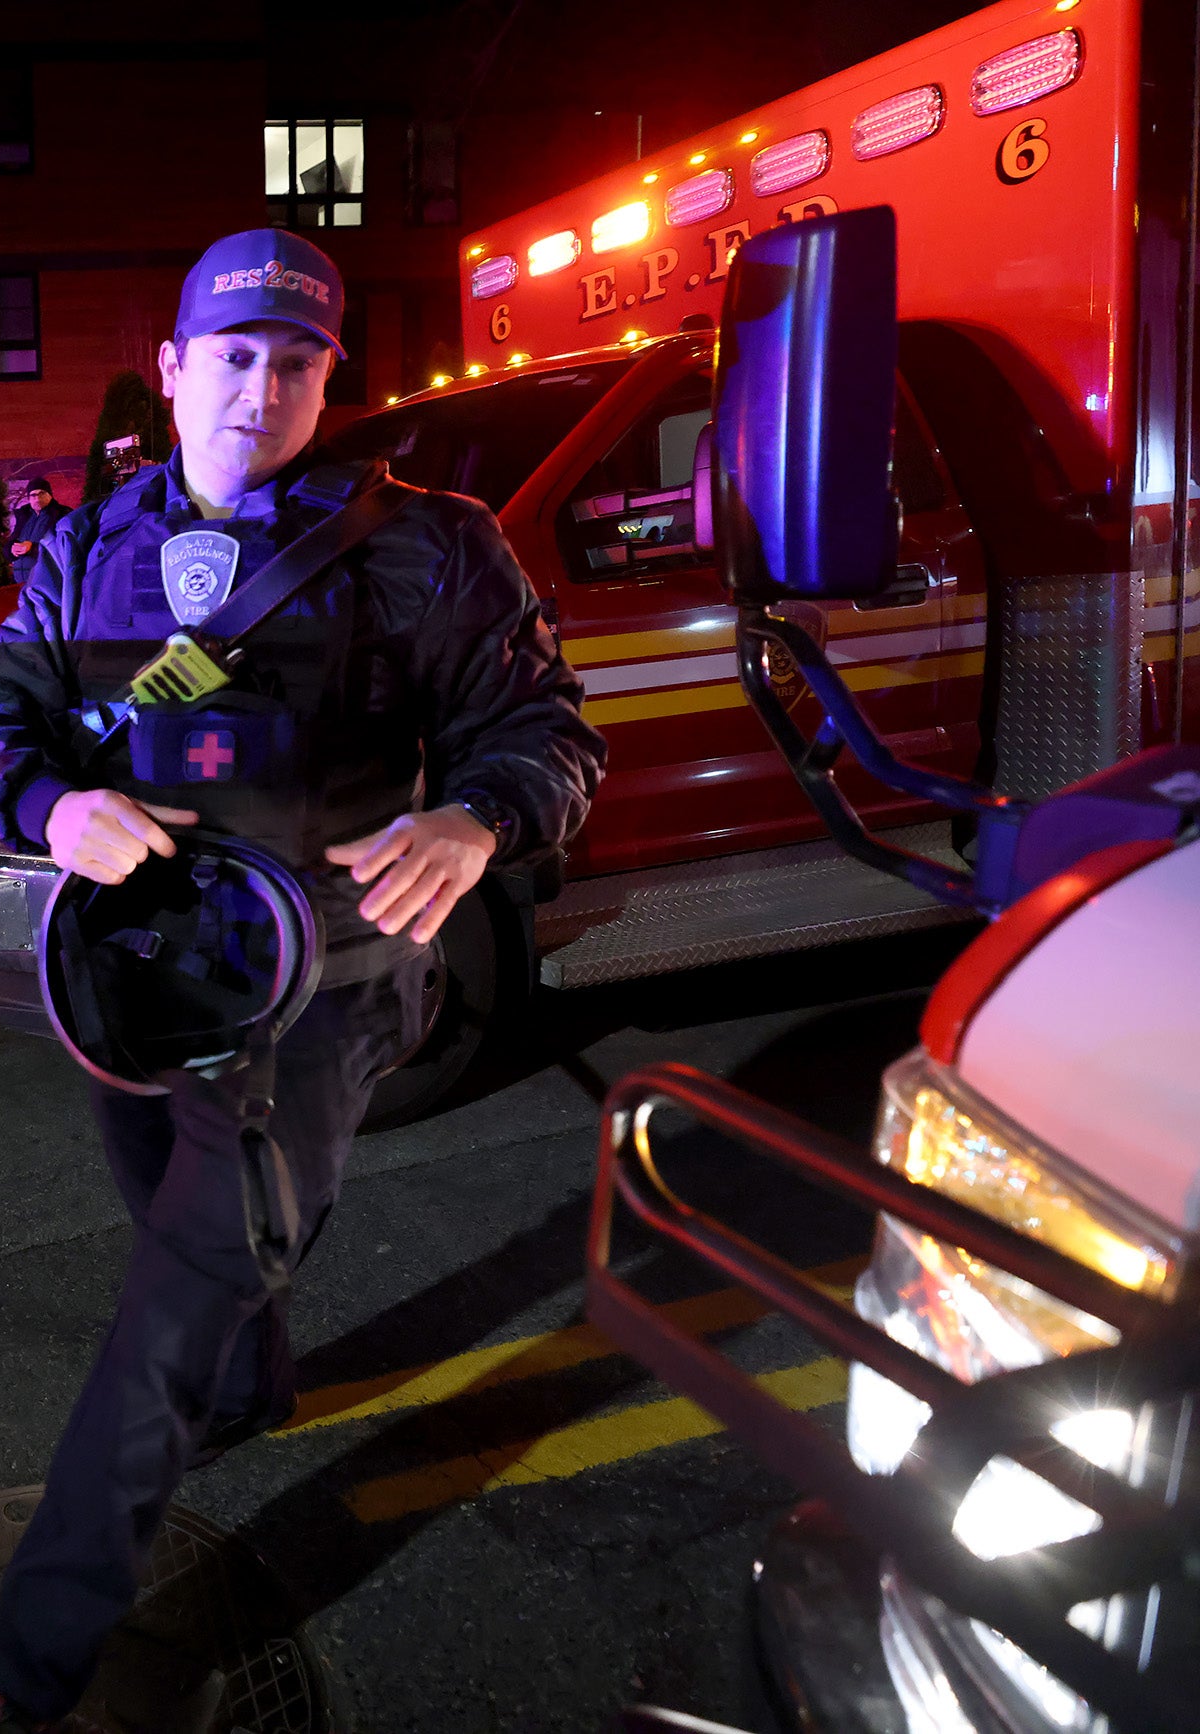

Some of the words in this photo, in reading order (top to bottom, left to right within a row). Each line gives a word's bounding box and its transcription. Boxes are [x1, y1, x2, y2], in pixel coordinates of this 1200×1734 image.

[995, 117, 1050, 186] 6
[490, 303, 512, 345] 6
[184, 605, 210, 617] FIRE
